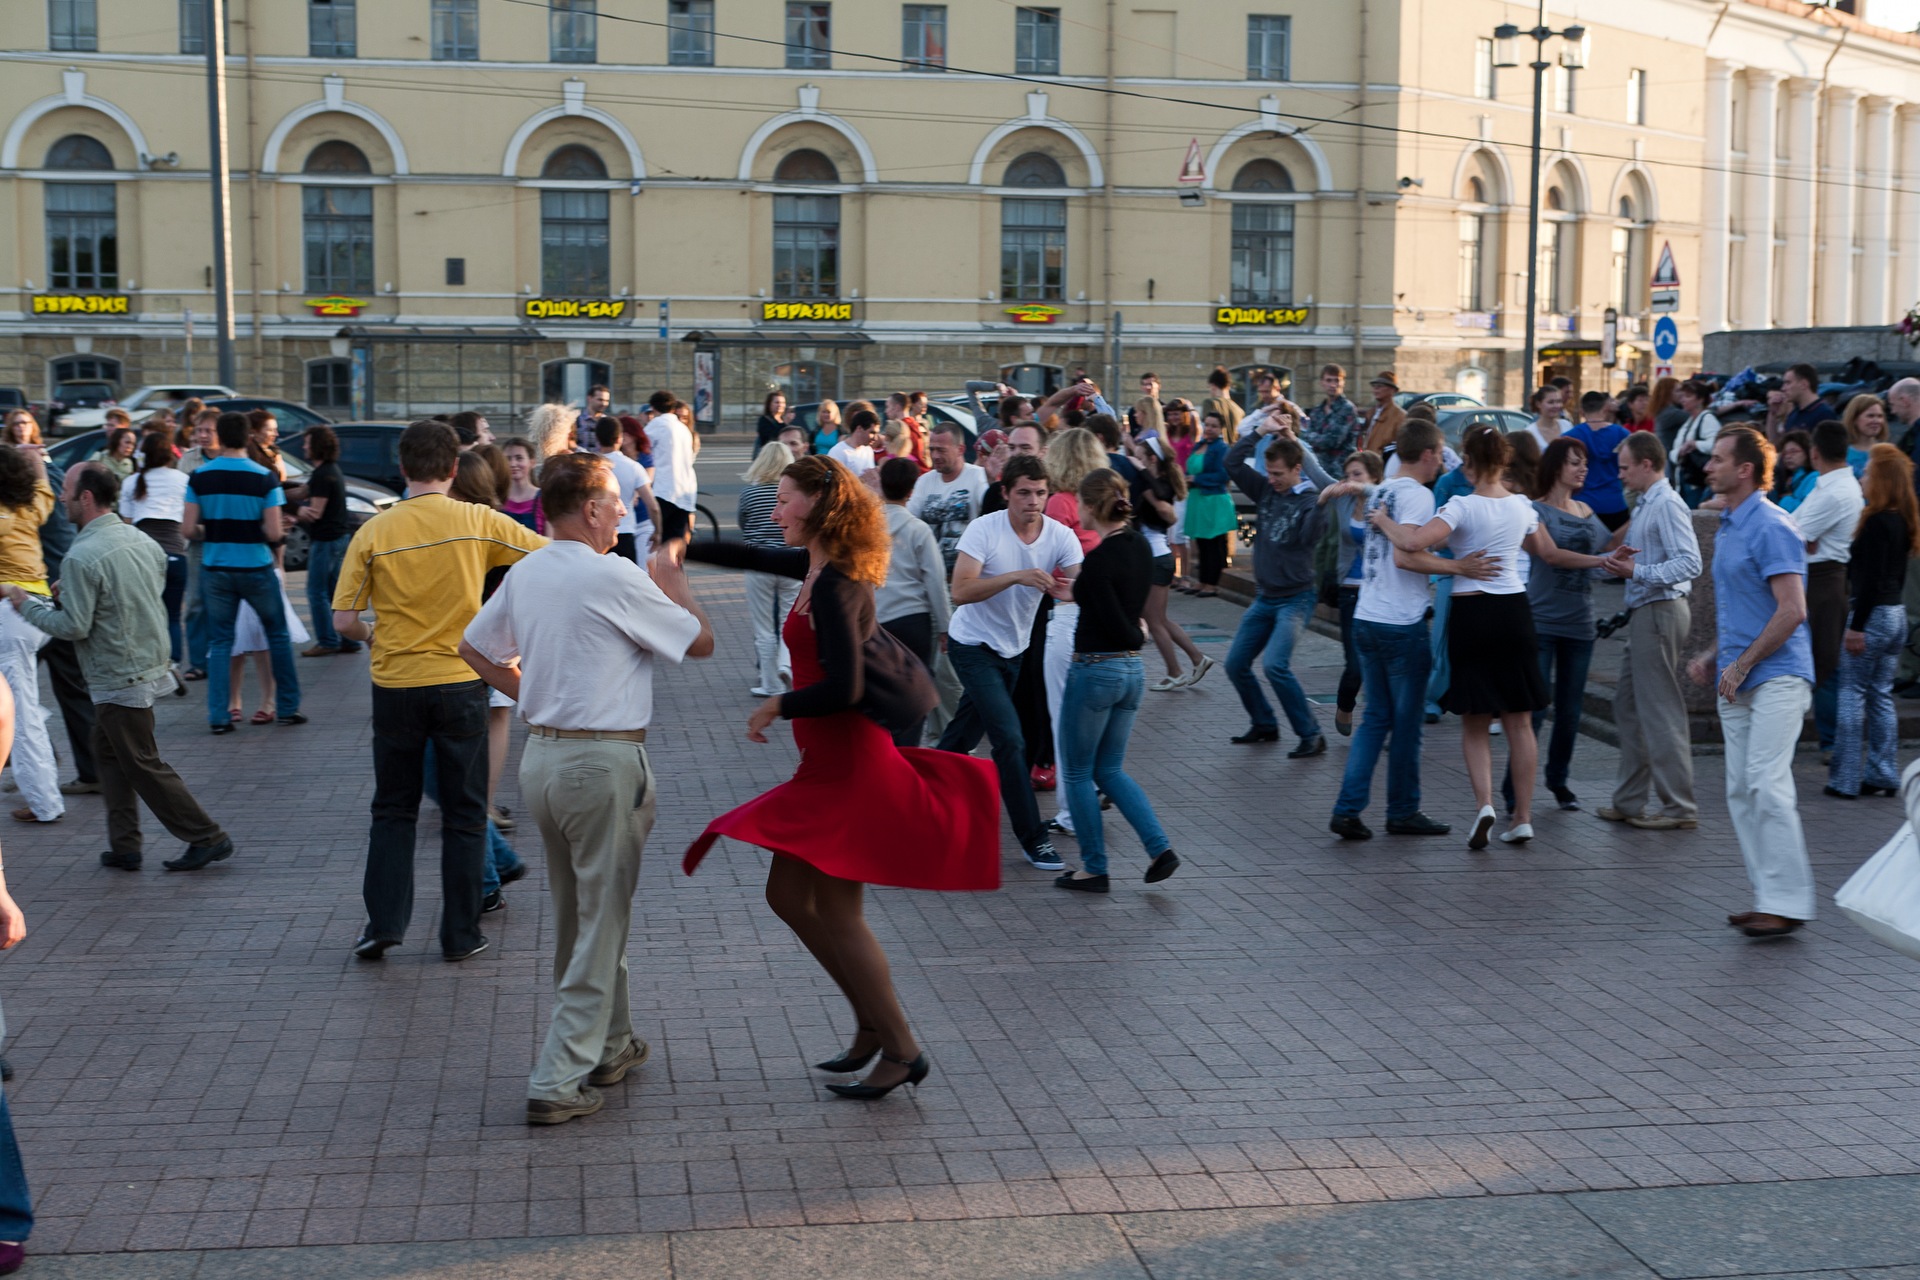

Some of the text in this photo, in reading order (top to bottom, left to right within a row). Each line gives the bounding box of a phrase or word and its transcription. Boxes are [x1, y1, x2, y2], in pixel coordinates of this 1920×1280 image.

[526, 300, 625, 318] СУШИ-БАР
[763, 303, 852, 319] ЕВРАЗИЯ
[1217, 308, 1308, 325] СУШИ-БАР
